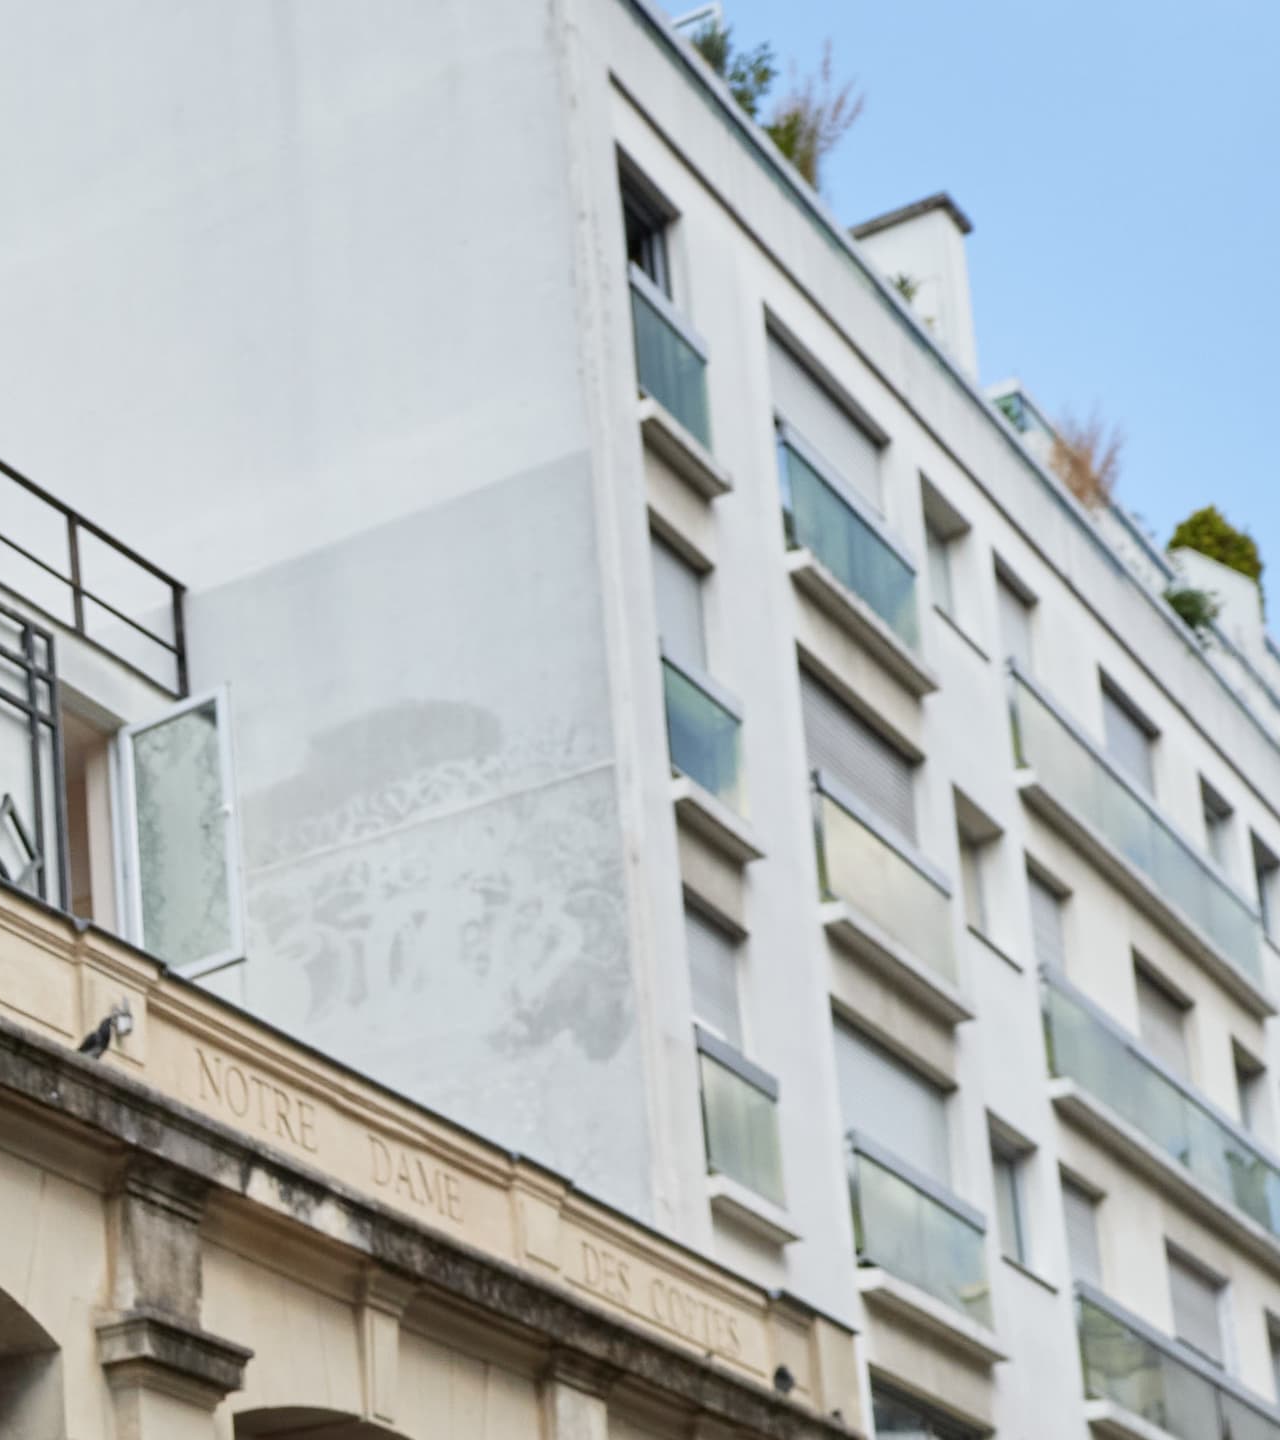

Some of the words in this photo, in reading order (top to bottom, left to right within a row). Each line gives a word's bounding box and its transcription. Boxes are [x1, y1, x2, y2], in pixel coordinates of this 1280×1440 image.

[195, 1047, 319, 1154] NOTRE
[367, 1133, 464, 1224] DAME
[580, 1240, 631, 1303] DES
